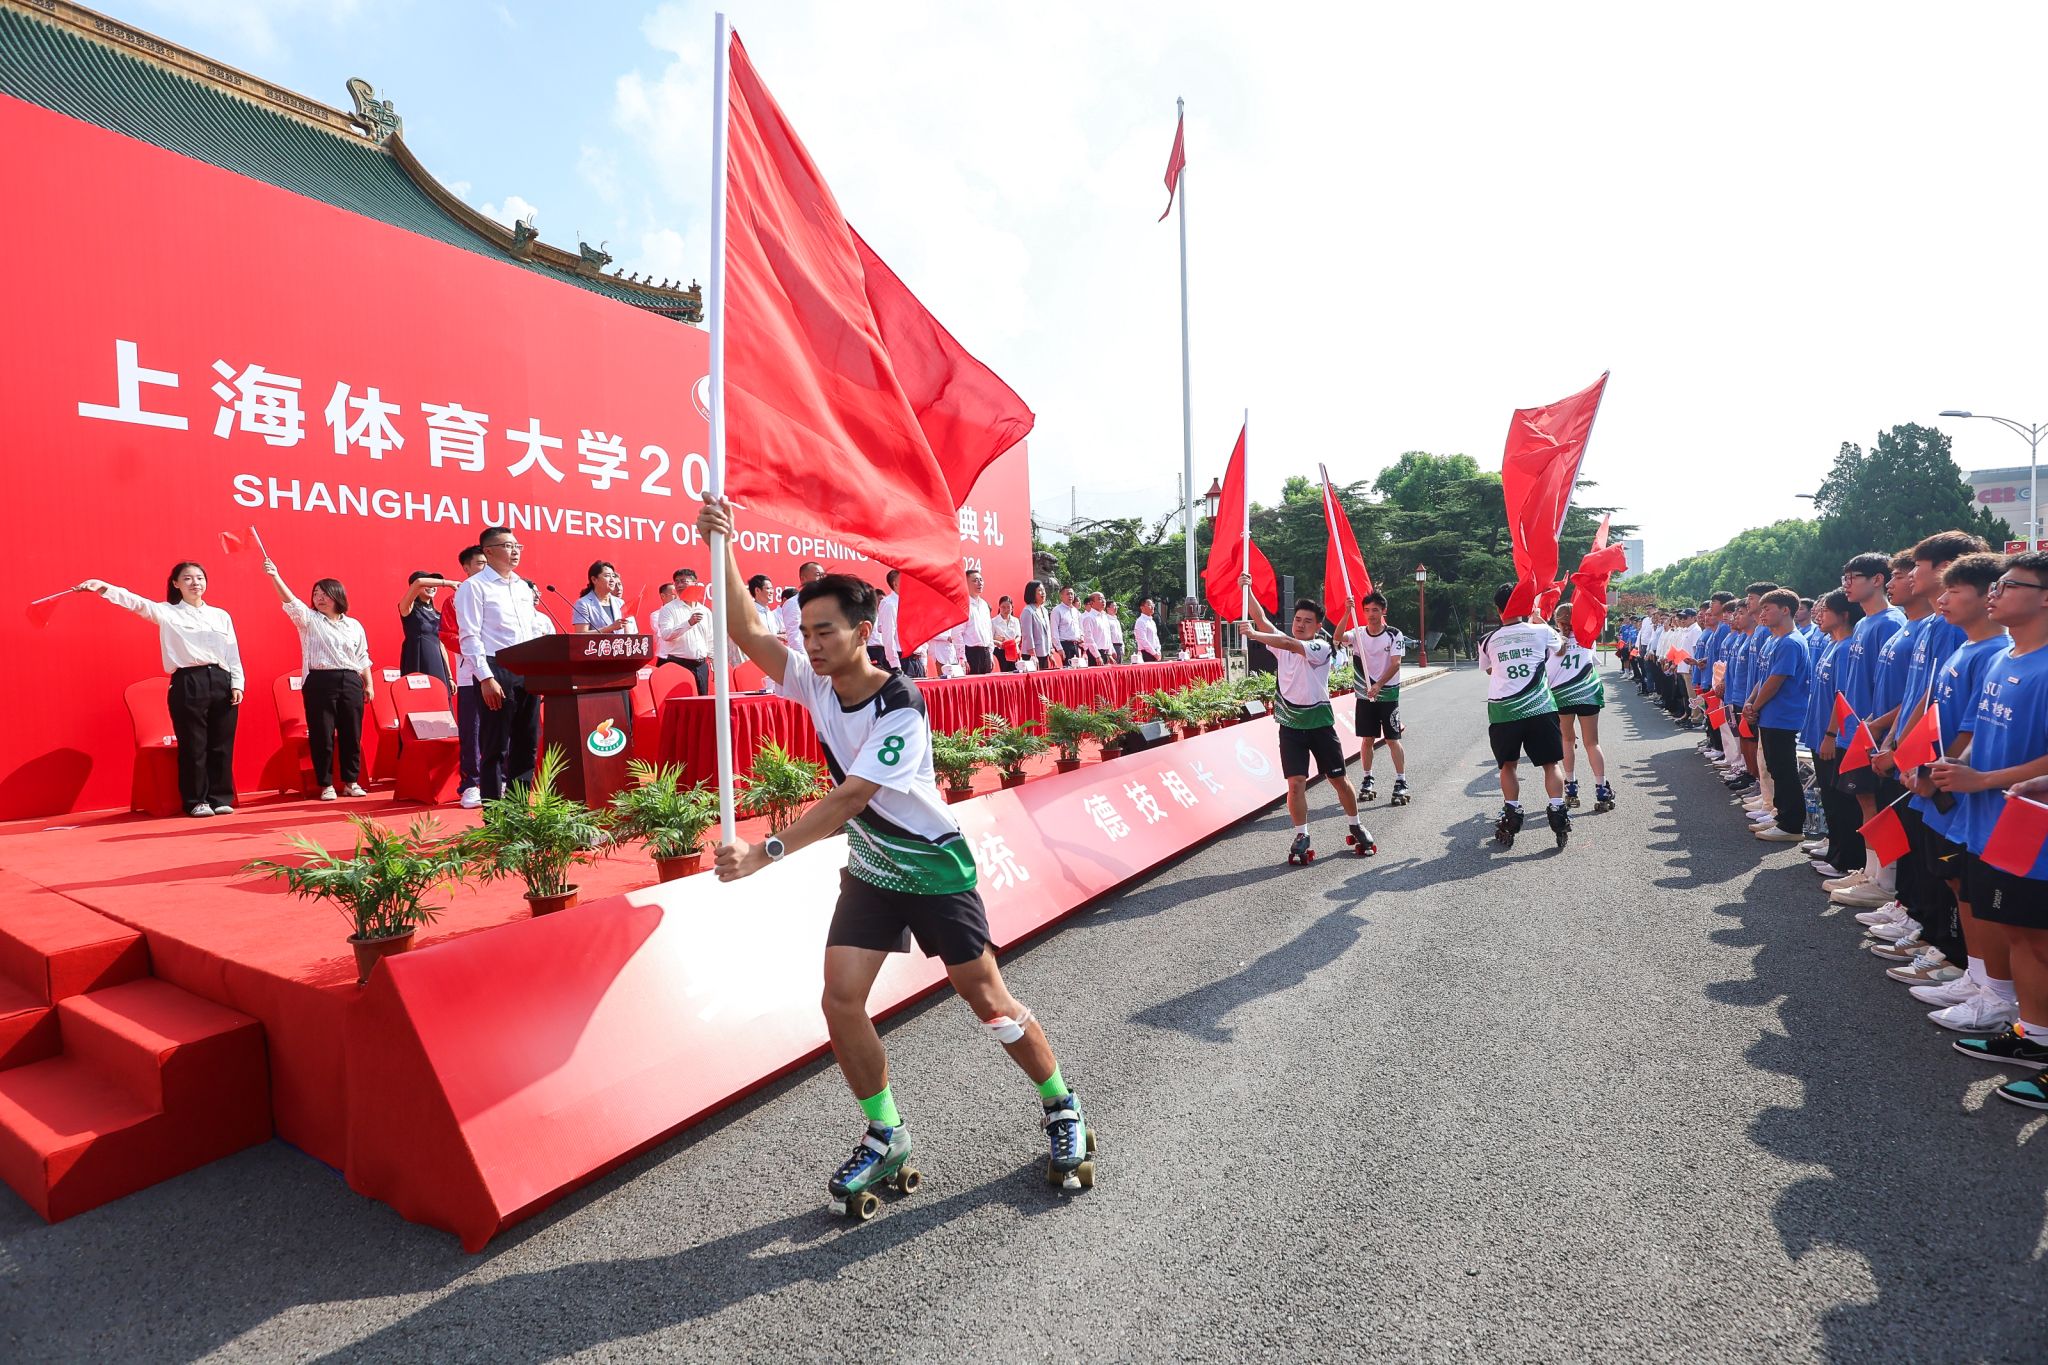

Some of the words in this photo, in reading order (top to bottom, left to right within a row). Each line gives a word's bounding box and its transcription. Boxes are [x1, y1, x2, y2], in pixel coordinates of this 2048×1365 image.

[232, 474, 470, 526] SHANGHAI
[480, 499, 666, 543] UNIVERSITY
[731, 529, 782, 556] PORT
[959, 505, 1004, 547] 典礼
[1507, 663, 1530, 680] 88
[1560, 653, 1581, 670] 41
[877, 735, 905, 766] 8
[1083, 760, 1225, 843] 德技相长
